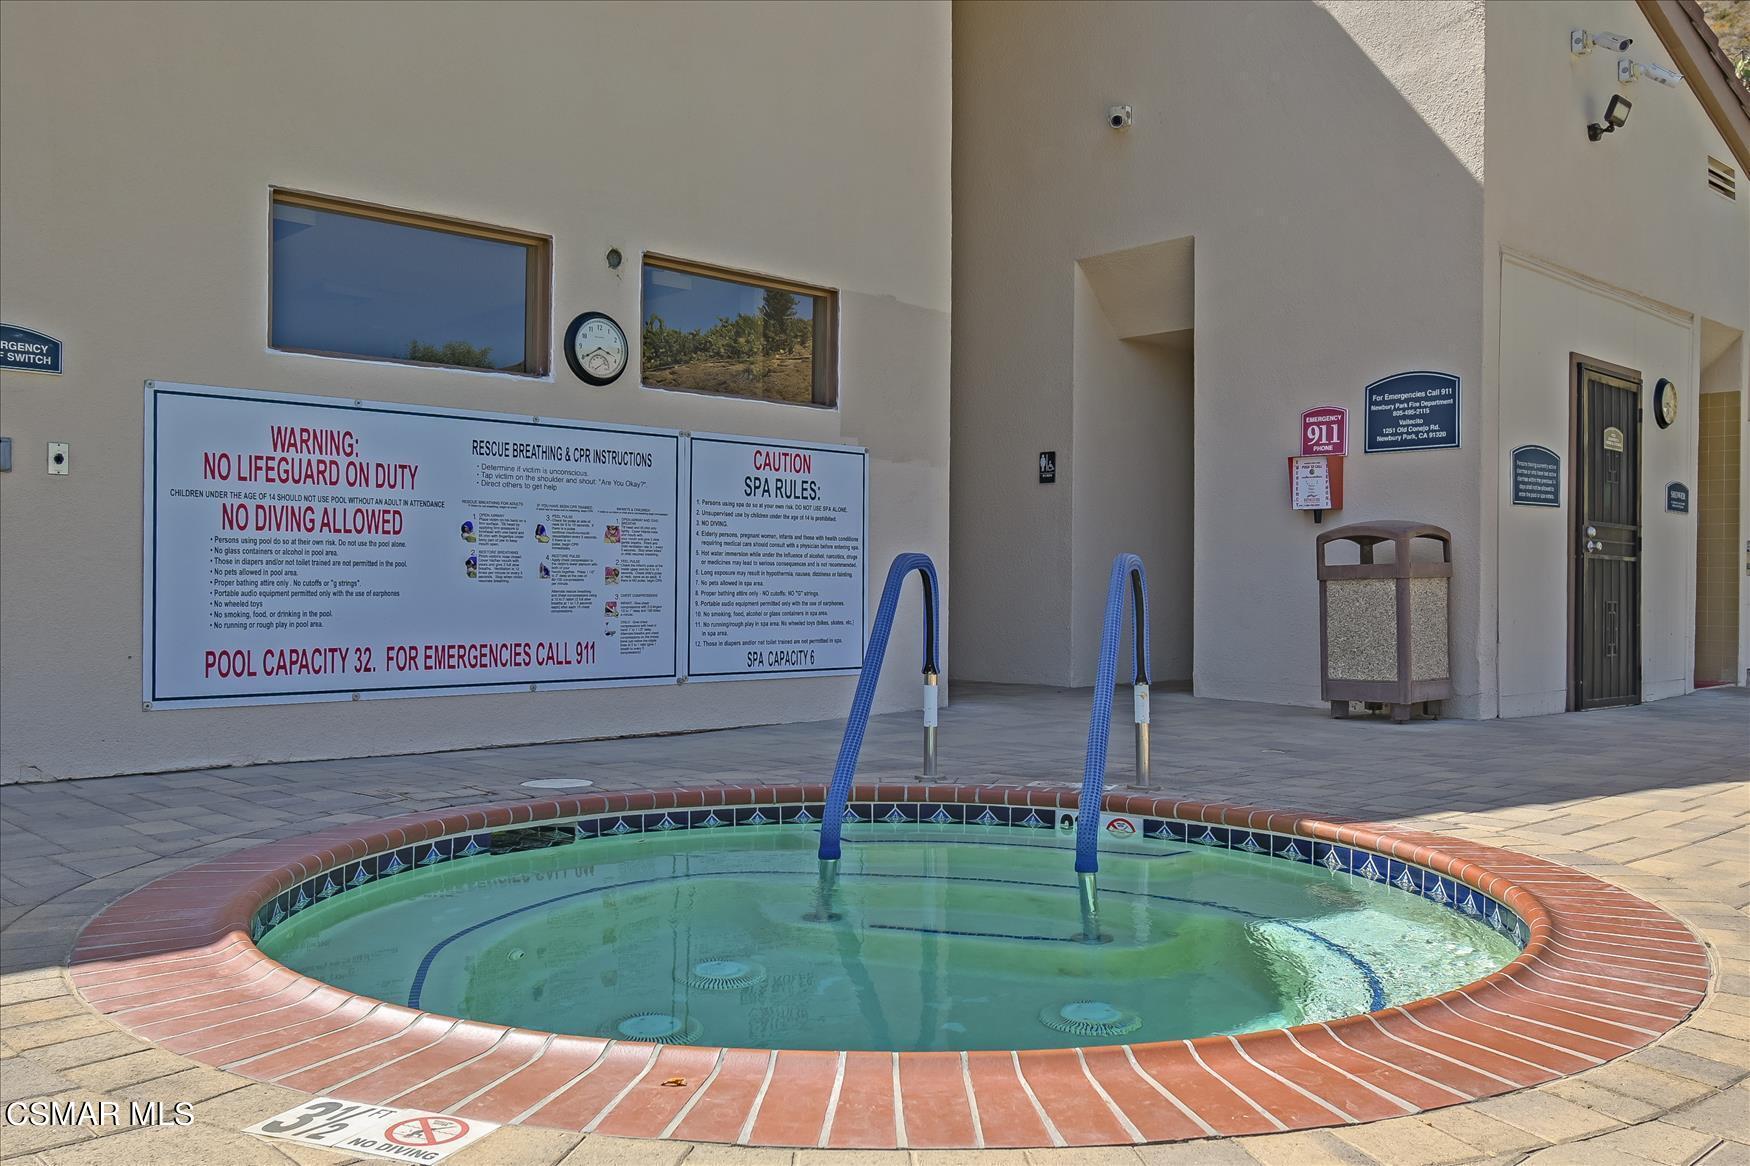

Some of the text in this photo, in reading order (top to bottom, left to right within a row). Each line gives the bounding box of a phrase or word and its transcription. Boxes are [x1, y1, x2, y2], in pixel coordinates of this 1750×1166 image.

[0, 340, 48, 354] RGENCY
[7, 352, 51, 365] SWITCH
[1384, 391, 1425, 400] Emergencies
[1420, 399, 1453, 408] Department
[1307, 424, 1340, 445] 911
[1407, 424, 1429, 432] Conejo
[271, 425, 359, 457] WARNING:
[1376, 434, 1401, 442] Newbury
[472, 439, 652, 467] RESCUE BREATHING & CPR INSTRUCTIONS
[480, 463, 515, 472] Determine
[754, 450, 812, 474] CAUTION
[204, 452, 418, 490] NO LIFEGUARD ON DUTY
[481, 472, 493, 481] Tap
[494, 472, 514, 482] victim
[536, 475, 564, 484] shoulder
[612, 479, 624, 488] You
[531, 483, 542, 491] get
[543, 483, 557, 491] help
[744, 476, 821, 500] SPA RULES:
[169, 488, 203, 497] CHILDREN
[204, 490, 228, 498] UNDER
[229, 491, 242, 499] THE
[243, 491, 256, 499] AGE
[276, 493, 302, 501] SHOULD
[303, 494, 316, 502] NOT
[330, 495, 346, 503] POOL
[347, 496, 374, 504] WITHOUT
[383, 498, 402, 506] ADULT
[409, 499, 444, 508] ATTENDANCE
[222, 503, 403, 535] NO DIVING ALLOWED
[240, 536, 257, 545] using
[258, 537, 272, 545] pool
[377, 540, 390, 548] pool
[223, 546, 240, 556] glass
[311, 548, 323, 557] pool
[224, 568, 237, 576] pets
[249, 600, 262, 608] toys
[276, 610, 300, 619] drinking
[205, 641, 596, 678] POOL CAPACITY 32. FOR EMERGENCIES CALL 911
[747, 650, 815, 667] SPA CAPACITY 6
[368, 1108, 398, 1119] FT
[347, 1137, 440, 1161] NO DIVING
